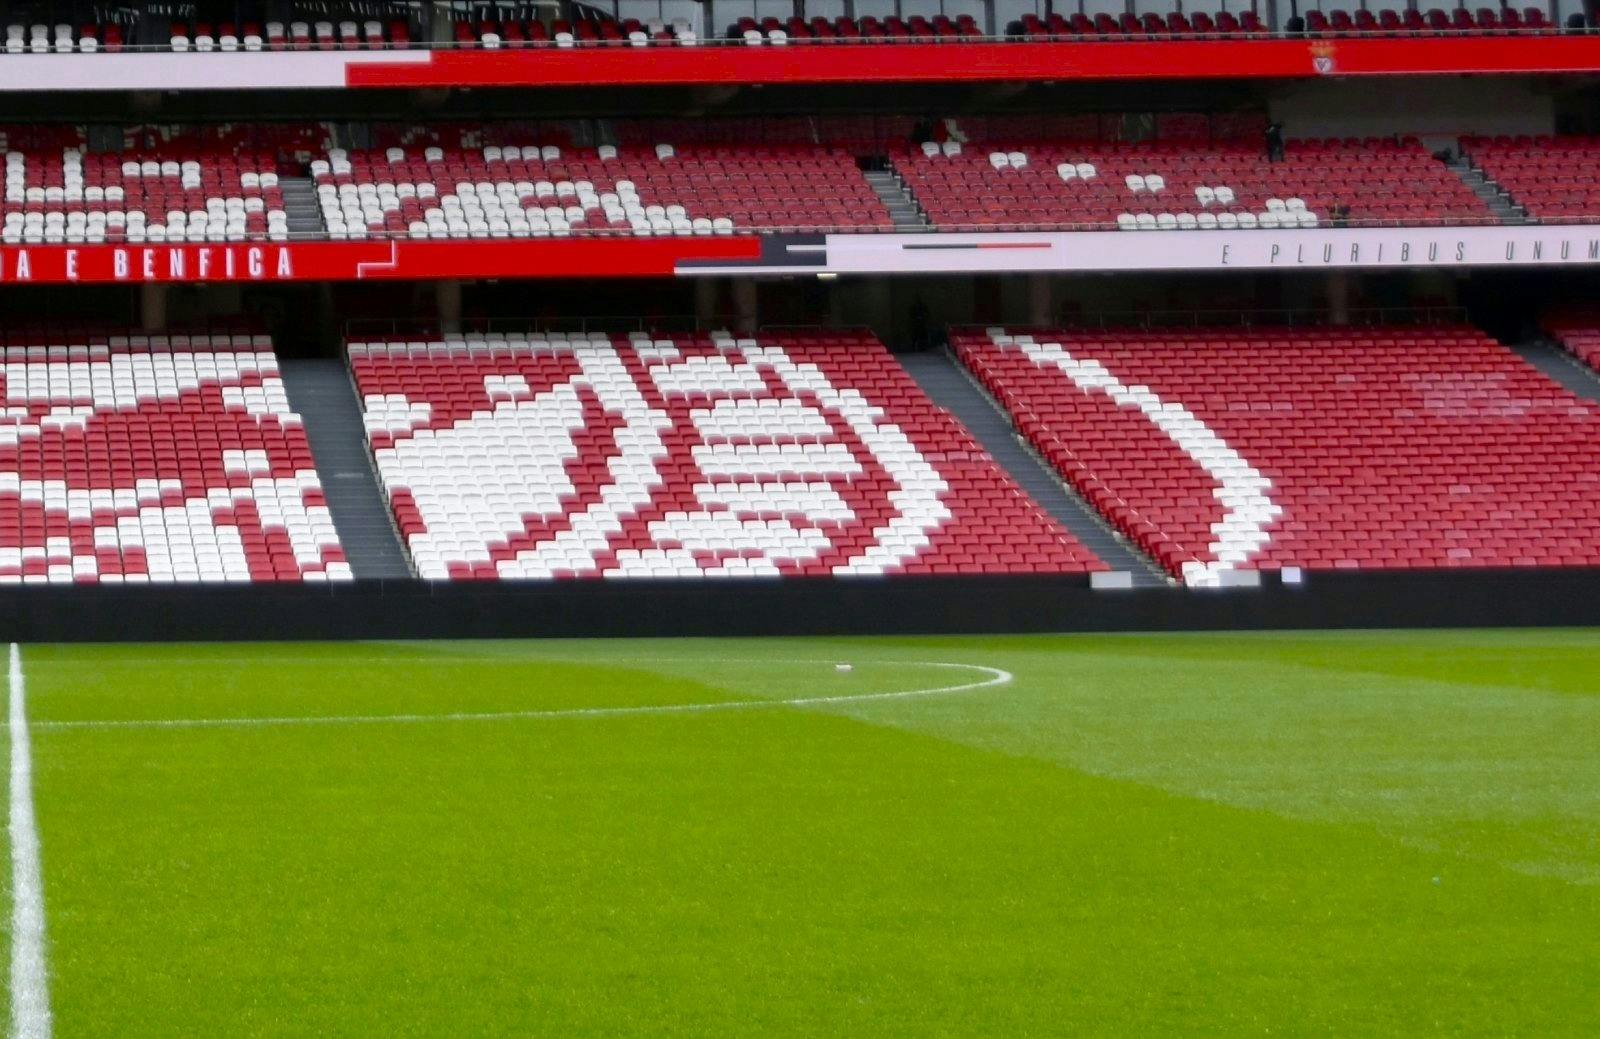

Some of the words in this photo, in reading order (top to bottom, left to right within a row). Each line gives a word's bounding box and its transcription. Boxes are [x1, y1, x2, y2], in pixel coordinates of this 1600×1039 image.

[65, 249, 79, 280] E
[113, 247, 293, 280] BENFICA
[1220, 244, 1230, 264] E
[1269, 241, 1465, 264] PLURIBUS
[1505, 240, 1600, 261] UNUM
